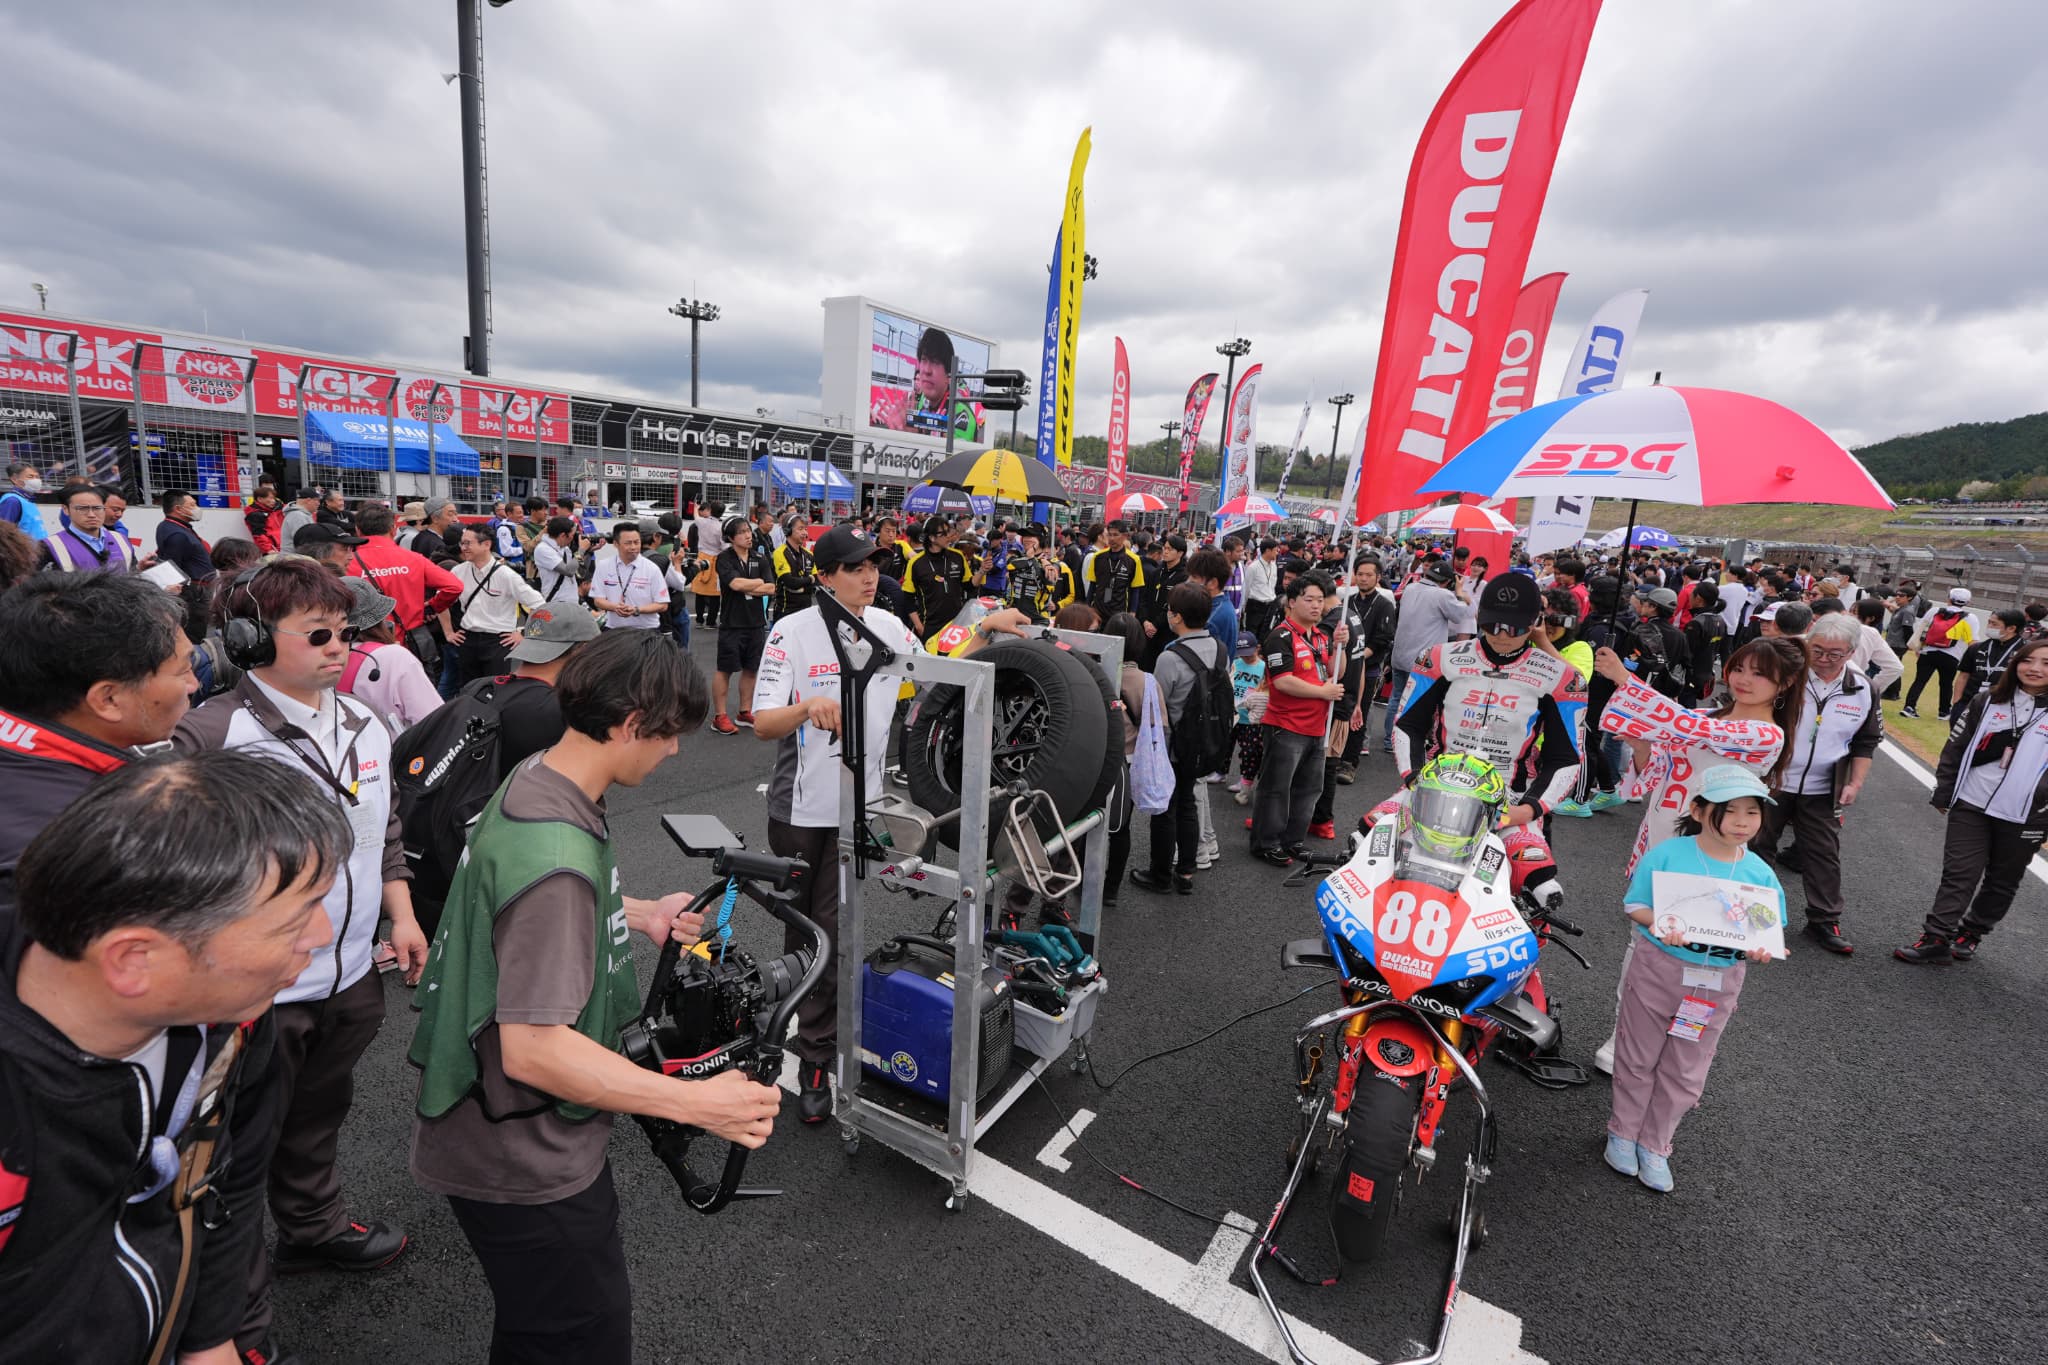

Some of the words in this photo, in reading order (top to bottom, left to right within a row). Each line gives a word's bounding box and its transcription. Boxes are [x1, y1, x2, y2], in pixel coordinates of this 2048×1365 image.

[1397, 109, 1523, 464] DUCATI
[0, 327, 137, 378] NGK
[0, 366, 67, 385] SPARK
[185, 358, 233, 377] NGK
[189, 377, 233, 389] SPARK
[190, 386, 234, 398] PLUGS
[277, 362, 378, 405] NGK
[412, 389, 446, 403] NGK
[414, 404, 447, 413] SPRK
[479, 390, 553, 426] NGK
[478, 420, 518, 433] SPAK
[641, 418, 731, 447] Honda
[737, 431, 812, 456] Dream
[863, 444, 942, 471] Panasonic
[1514, 442, 1689, 478] SDG
[607, 466, 614, 475] 5
[939, 626, 964, 645] 45
[808, 663, 839, 677] SDG
[1459, 667, 1481, 676] RK
[1510, 675, 1541, 688] MOTUL
[1461, 689, 1520, 710] SDG
[1448, 773, 1473, 785] Arai
[1480, 846, 1497, 872] DELIGHT
[1488, 853, 1502, 875] WORKS
[1343, 870, 1369, 897] MOTUL
[1318, 890, 1366, 940] SDG
[1377, 891, 1451, 957] 88
[1475, 910, 1513, 929] MOTUL
[1688, 926, 1746, 941] R.MIZUNO
[1382, 951, 1434, 972] DUCATI
[1466, 937, 1529, 976] SDG
[1393, 964, 1432, 979] KAGAYAMA
[1349, 976, 1392, 995] KYOEI
[1411, 994, 1462, 1018] KYOEI
[682, 1051, 730, 1075] RONIN
